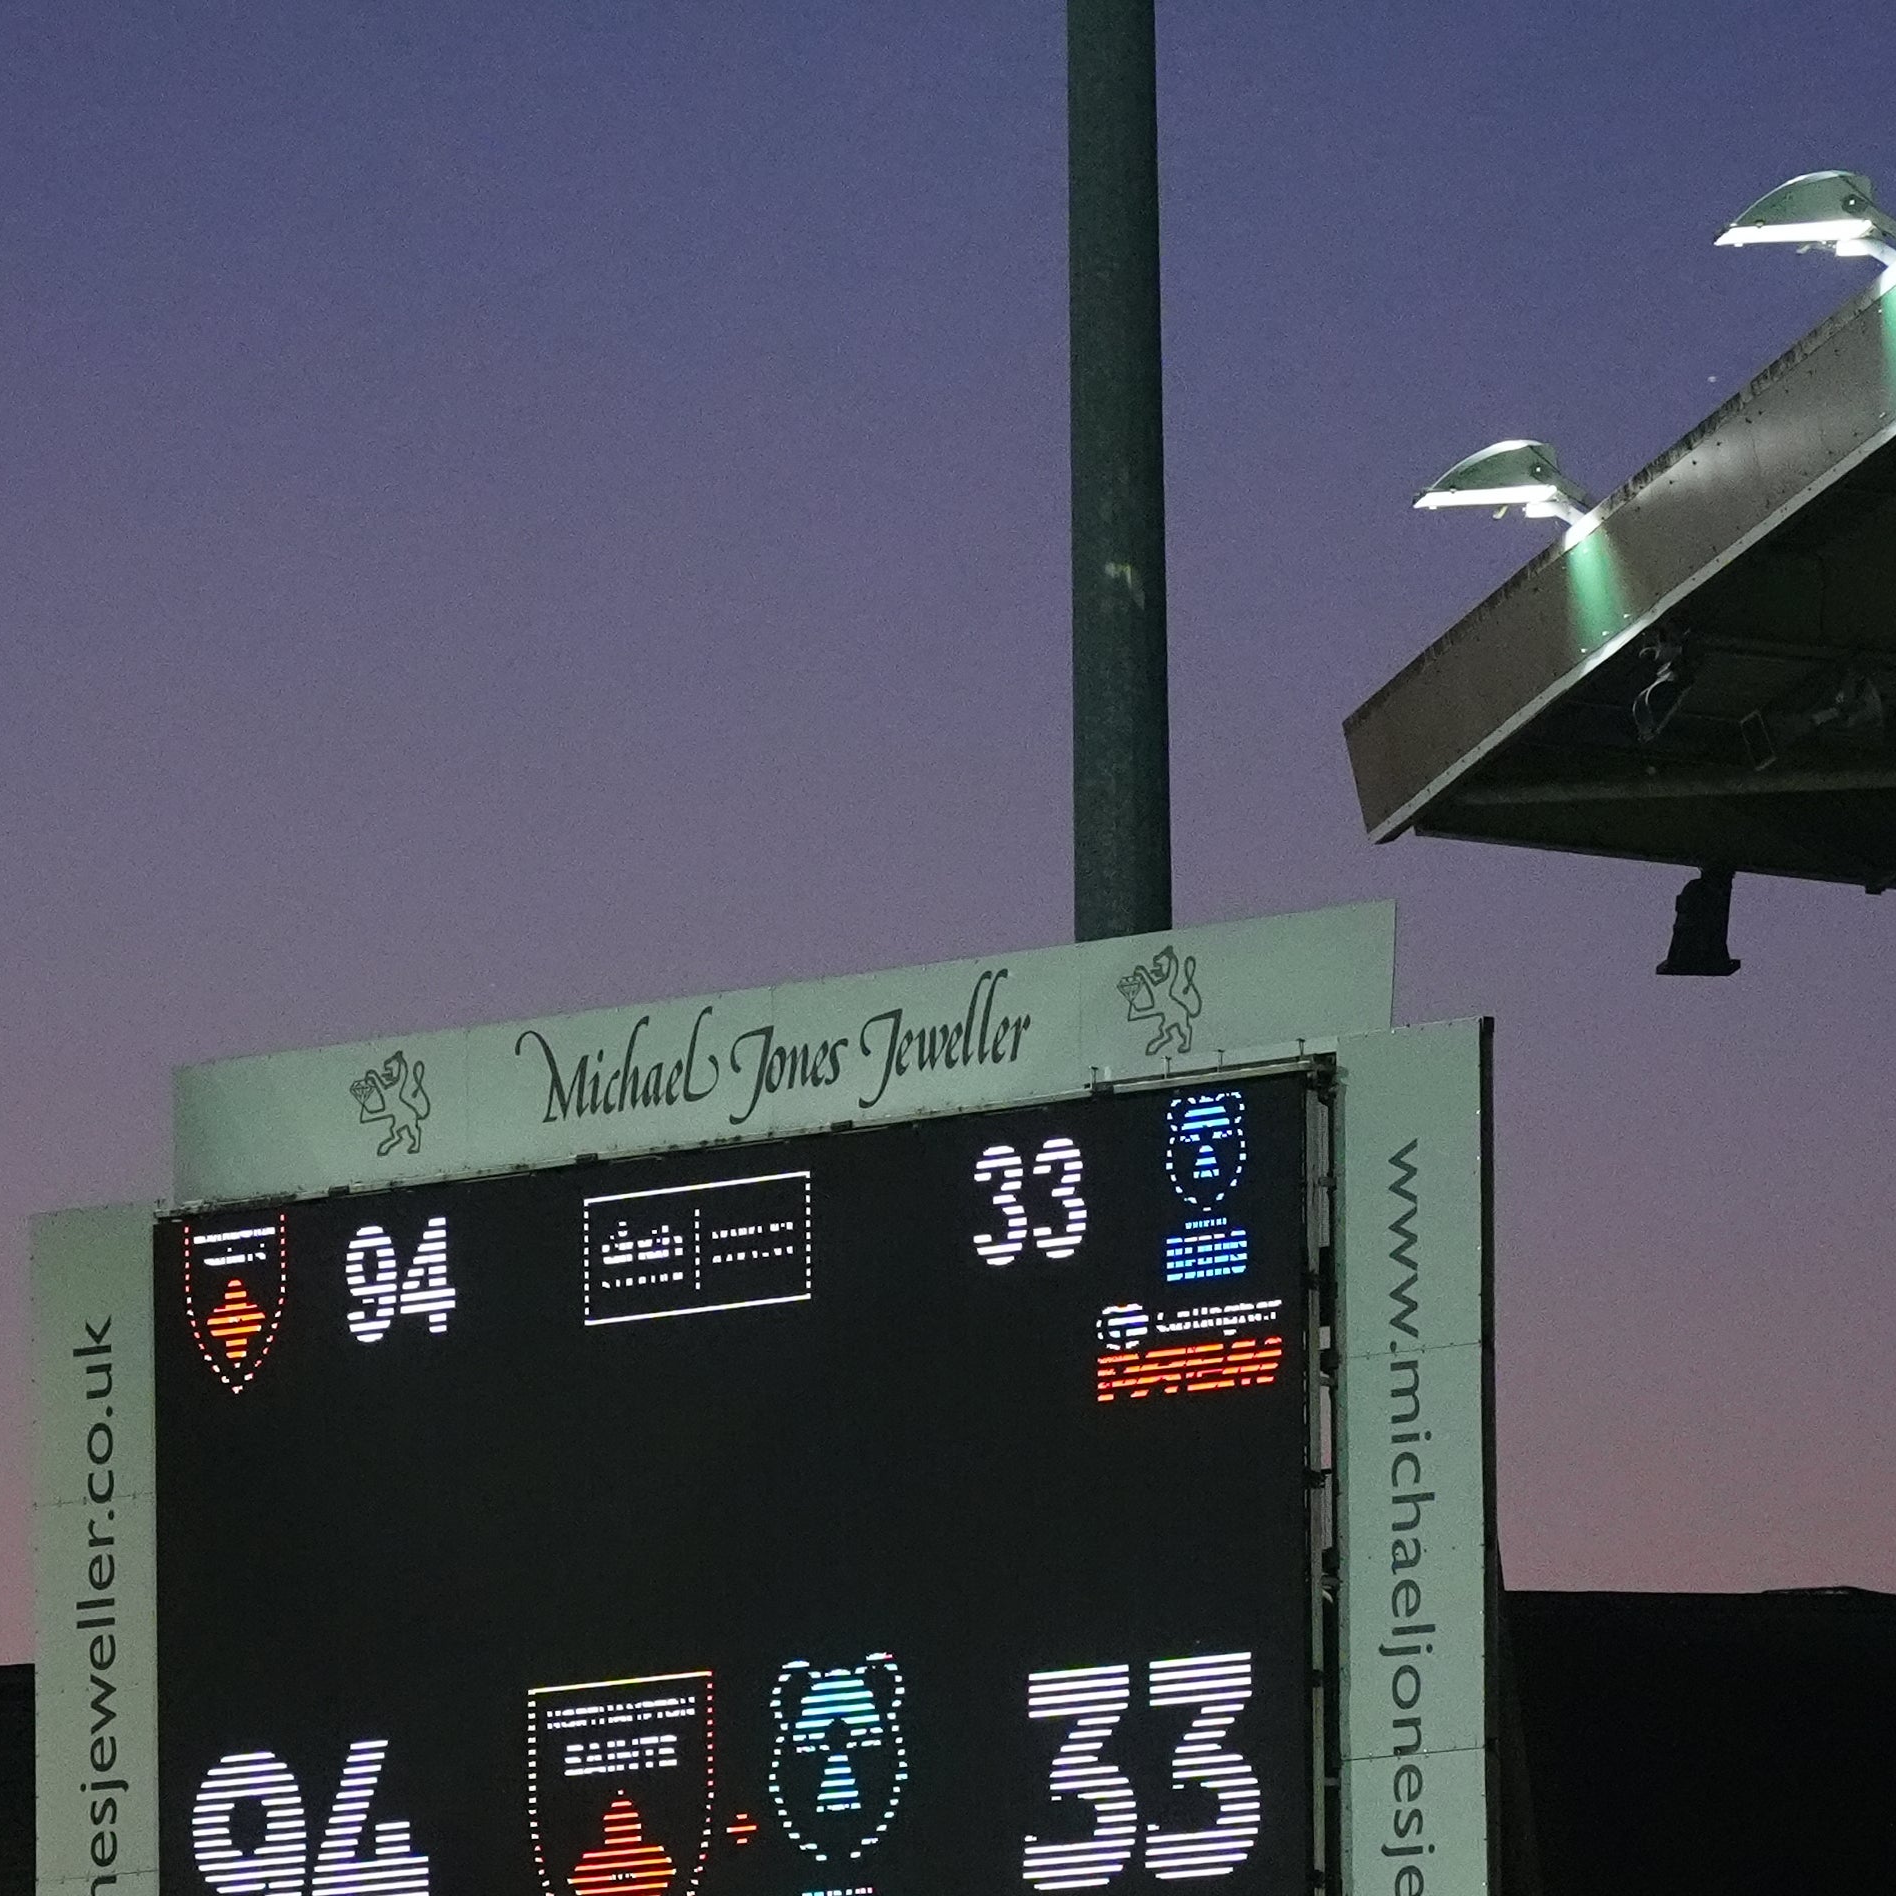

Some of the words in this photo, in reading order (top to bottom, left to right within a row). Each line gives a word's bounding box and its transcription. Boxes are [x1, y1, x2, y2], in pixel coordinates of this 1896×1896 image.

[514, 1005, 720, 1124] Michael
[728, 1024, 849, 1126] Jones
[857, 968, 1032, 1109] Jeweller
[973, 1137, 1087, 1266] 33
[345, 1215, 456, 1342] 94
[1023, 1652, 1260, 1891] 33
